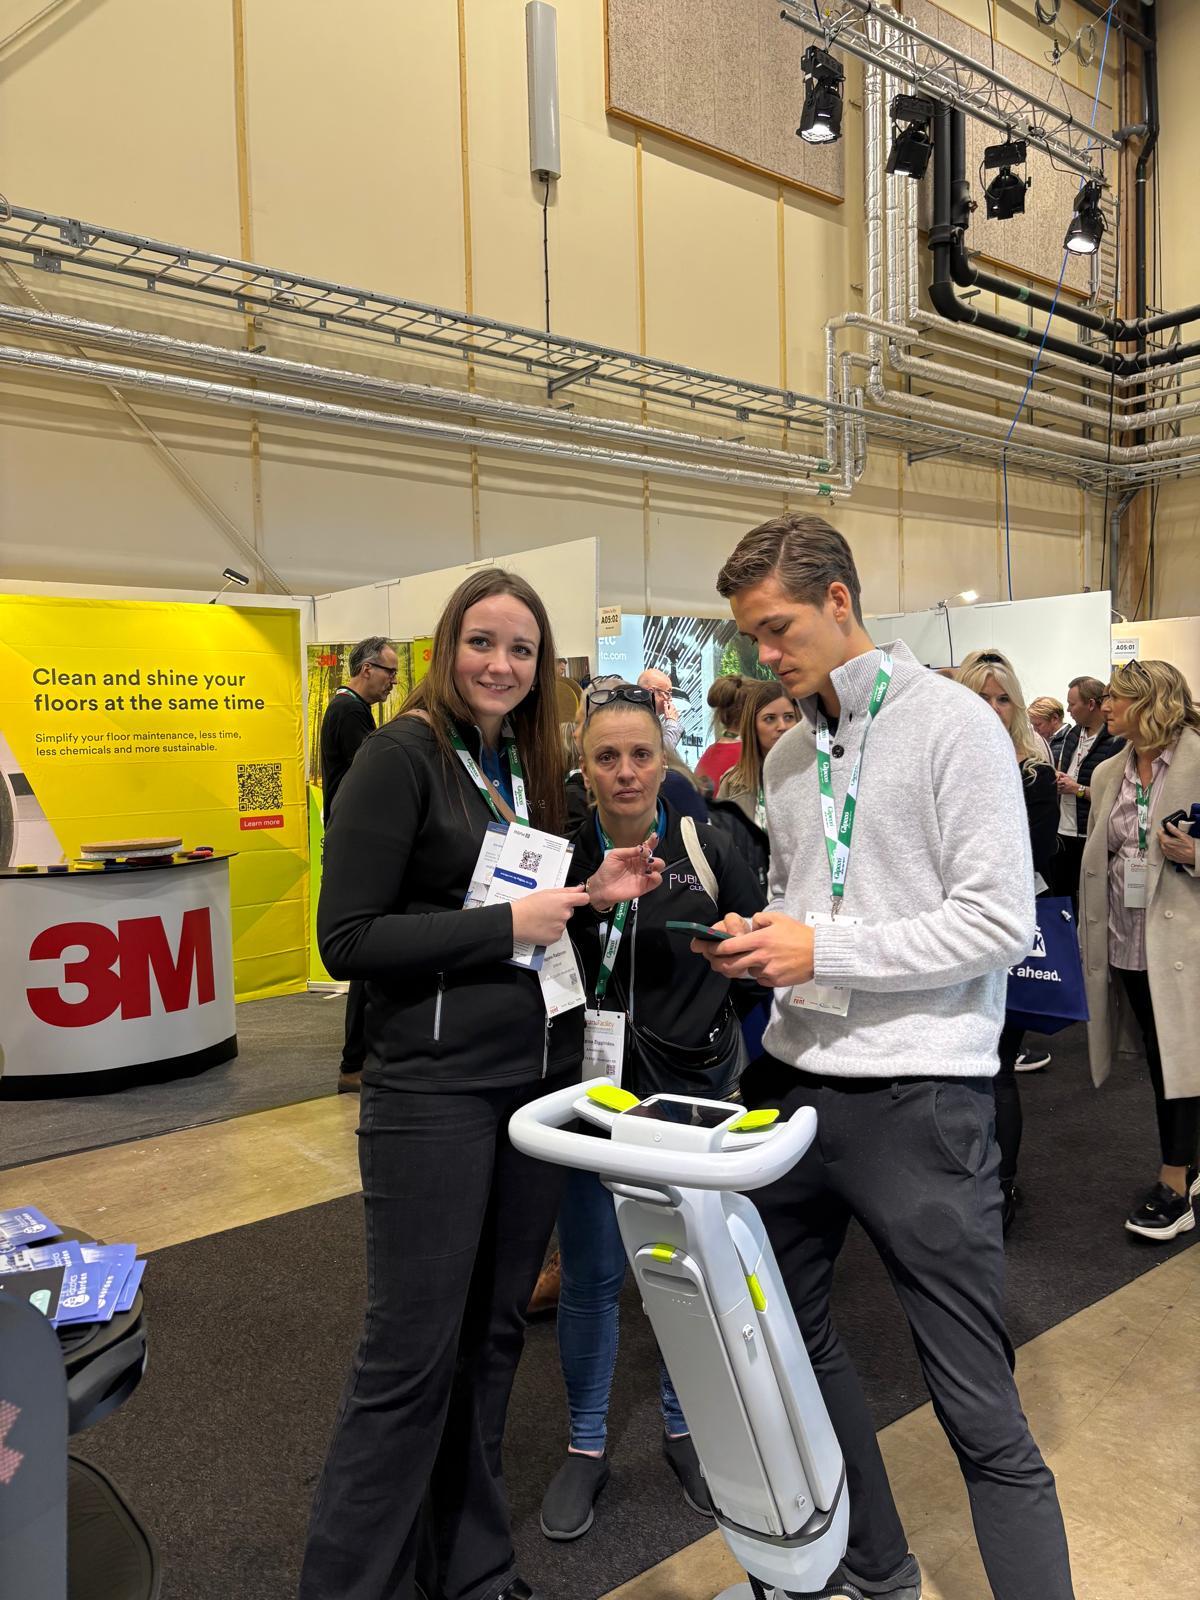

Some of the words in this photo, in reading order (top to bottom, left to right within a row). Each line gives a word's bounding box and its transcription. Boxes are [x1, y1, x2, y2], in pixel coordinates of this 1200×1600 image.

[32, 668, 96, 686] Clean
[103, 669, 140, 686] and
[147, 669, 198, 686] shine
[203, 675, 246, 690] your
[34, 694, 98, 711] floors
[105, 696, 124, 710] at
[130, 694, 162, 710] the
[168, 698, 218, 710] same
[224, 694, 264, 710] time
[36, 733, 78, 744] Simplify
[81, 735, 104, 744] your
[107, 732, 130, 741] floor
[133, 731, 196, 740] maintenance,
[200, 730, 216, 739] less
[219, 730, 241, 740] time,
[36, 747, 56, 756] less
[60, 746, 111, 755] chemicals
[114, 745, 132, 754] and
[162, 743, 218, 752] sustainable.
[26, 906, 215, 1027] 3M
[1017, 966, 1062, 982] ahead.
